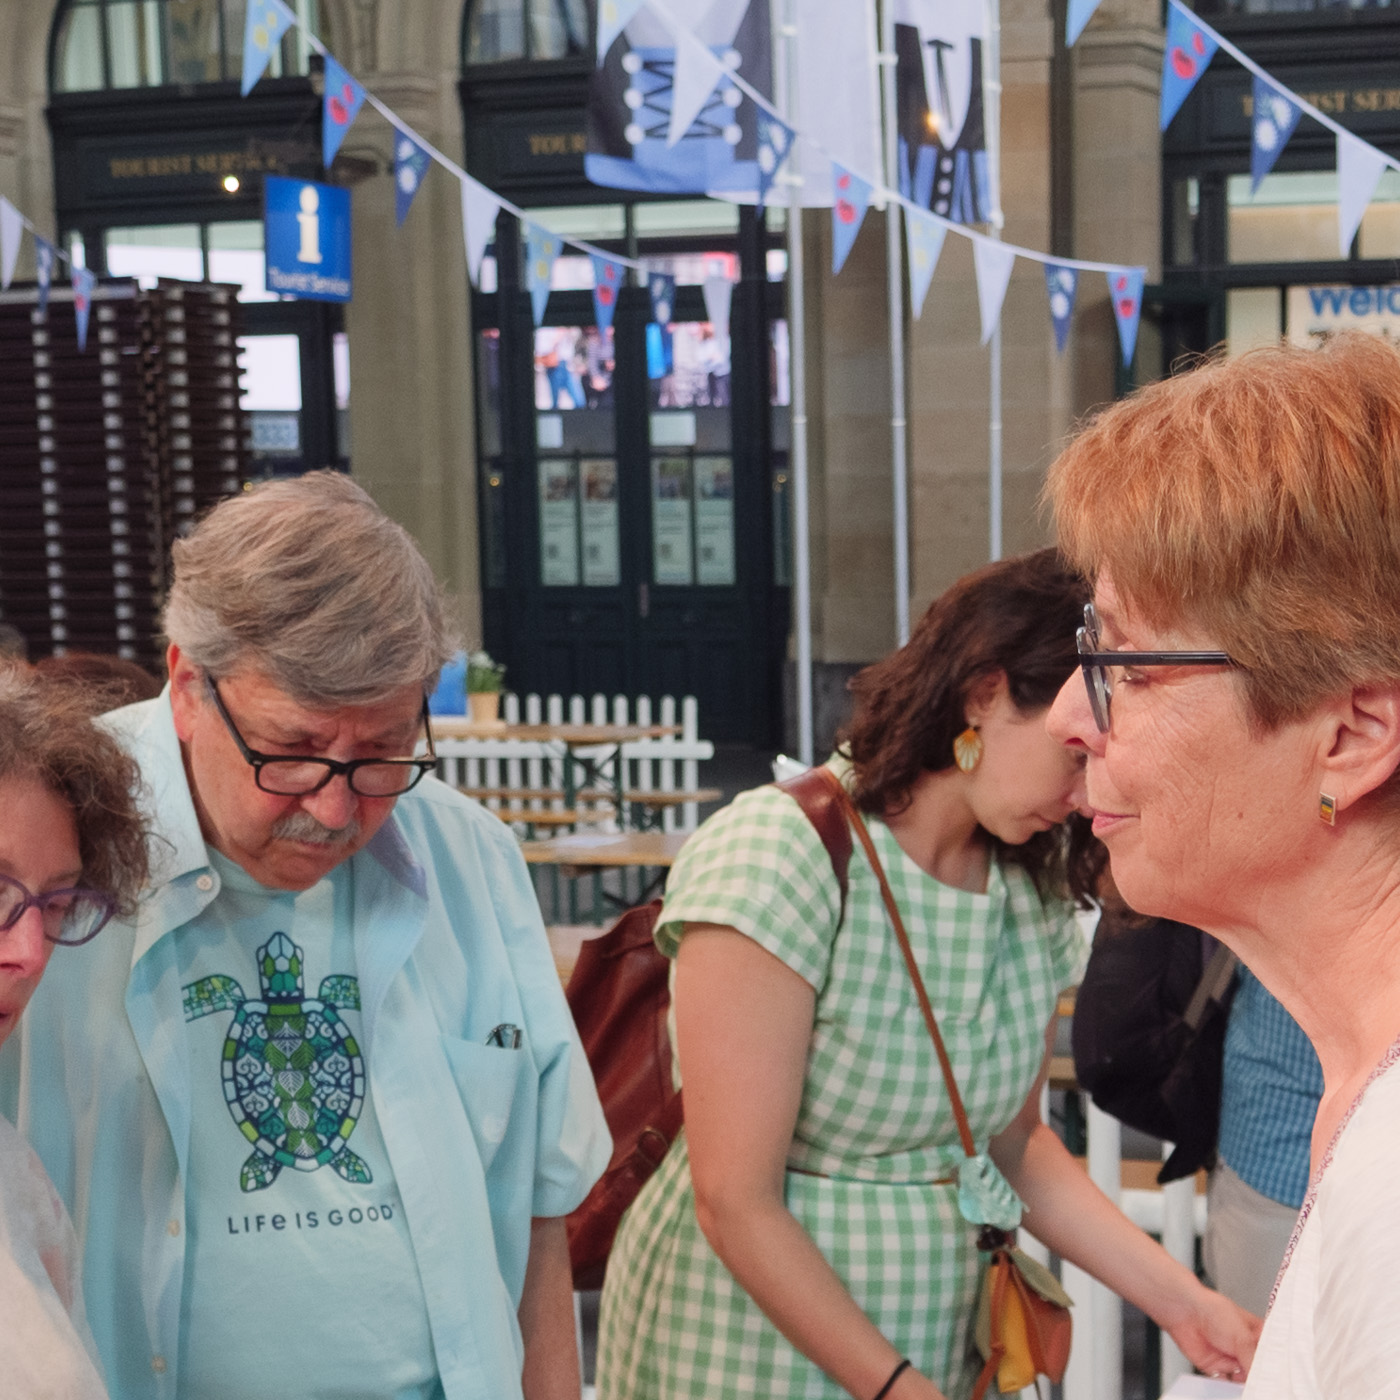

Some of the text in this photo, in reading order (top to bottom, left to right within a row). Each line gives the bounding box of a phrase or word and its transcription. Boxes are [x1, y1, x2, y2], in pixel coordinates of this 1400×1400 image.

[1242, 91, 1346, 118] TIST
[529, 133, 586, 154] TOUR
[110, 155, 193, 178] TOURIST
[296, 1210, 320, 1230] IS
[328, 1203, 394, 1227] GOOD
